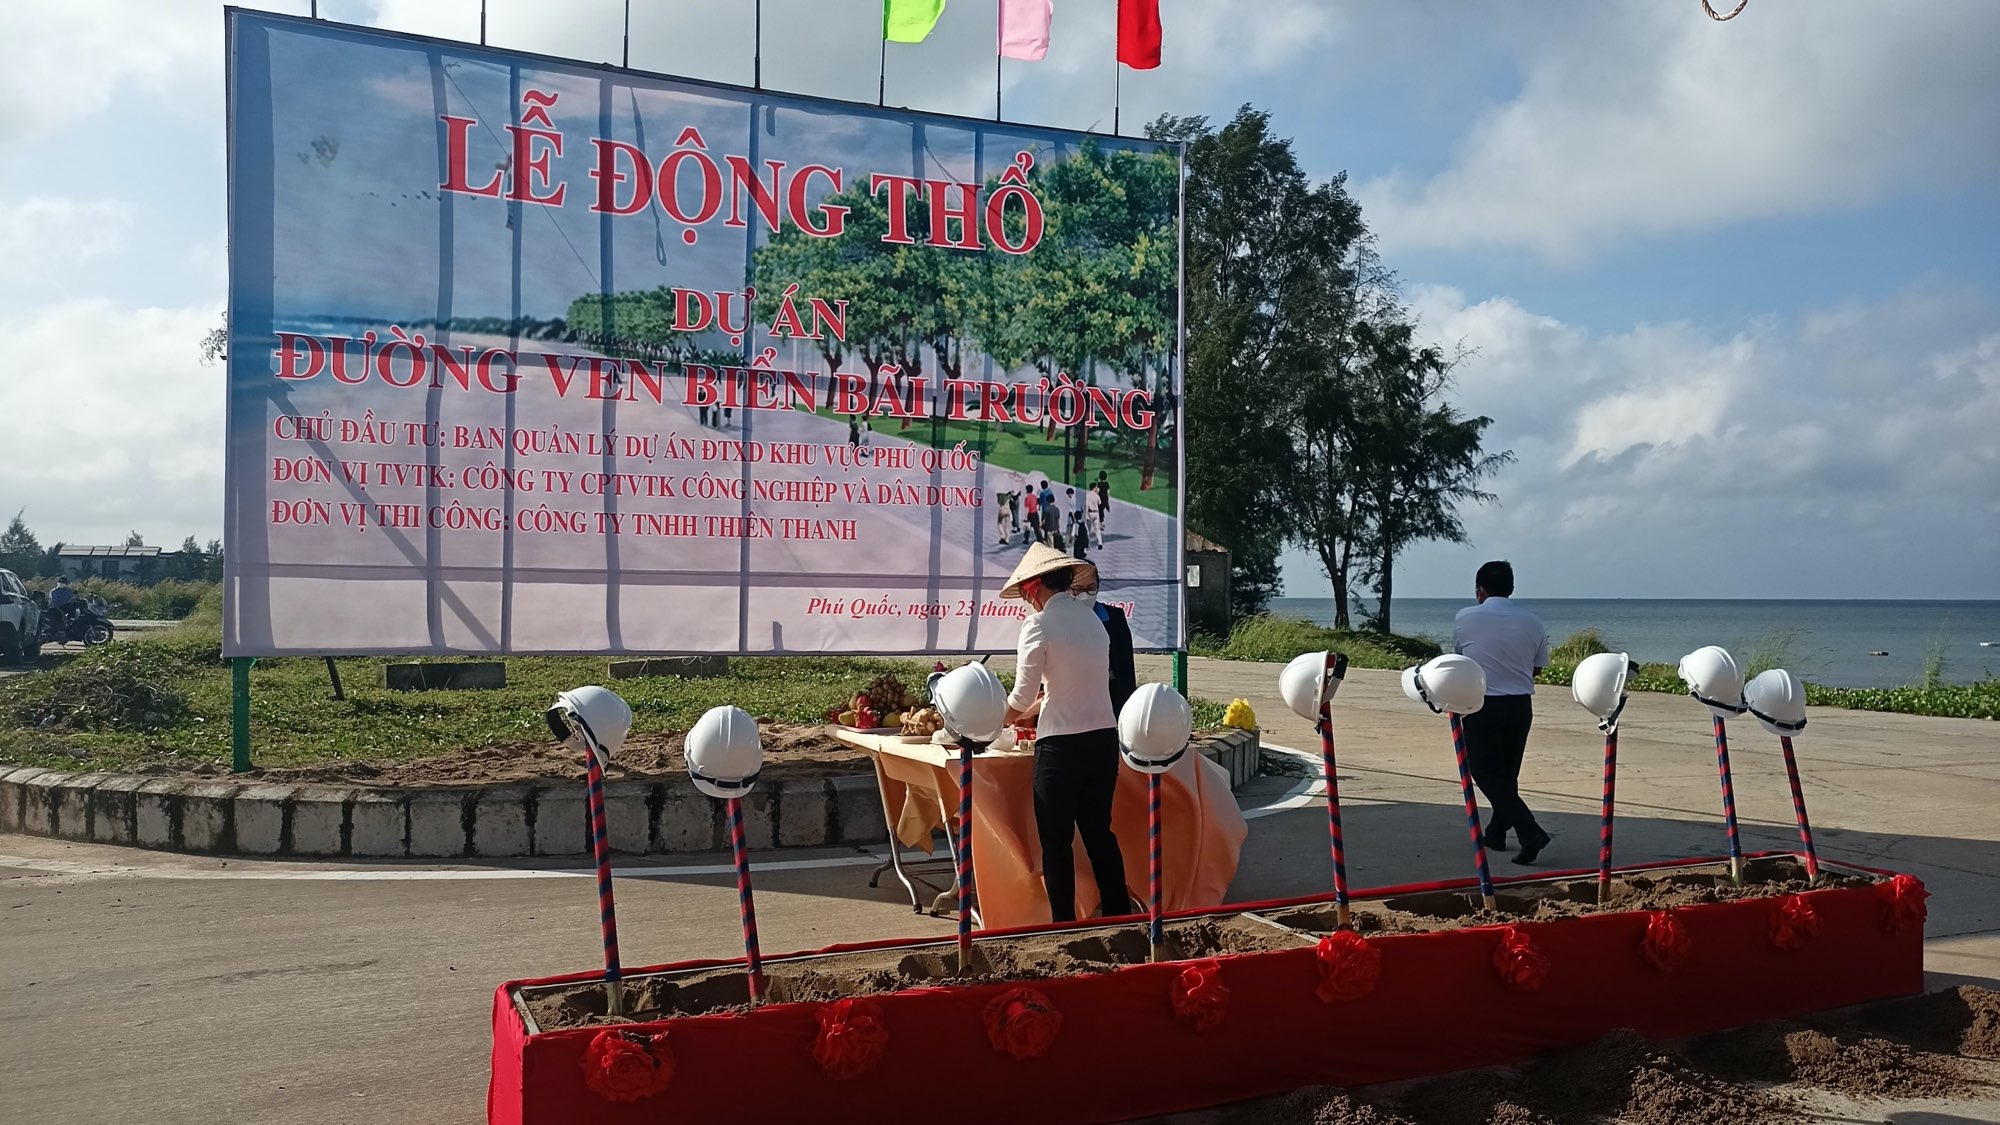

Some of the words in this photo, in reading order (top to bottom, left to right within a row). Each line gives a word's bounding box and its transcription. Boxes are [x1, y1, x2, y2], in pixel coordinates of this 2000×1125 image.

[440, 89, 567, 208] LỄ
[589, 126, 851, 245] ĐỘNG
[871, 151, 1045, 254] THỔ
[671, 287, 756, 346] DỰ
[769, 283, 849, 341] ÁN
[274, 325, 523, 394] ĐƯỜNG
[540, 353, 665, 405] VEN
[682, 346, 820, 414] BIỂN
[833, 363, 931, 418] BÃI
[943, 372, 1156, 429] TRƯỜNG
[274, 410, 334, 442] CHỦ
[340, 408, 396, 446] ĐẦU
[403, 420, 446, 448] TƯ:
[453, 425, 506, 450] BAN
[512, 423, 581, 456] QUẢN
[587, 428, 617, 456] LÝ
[625, 434, 659, 464] DỰ
[664, 431, 696, 461] ÁN
[701, 440, 764, 463] ĐTXD
[769, 443, 818, 466] KHU
[823, 444, 869, 474] VỰC
[873, 442, 917, 470] PHÚ
[921, 440, 981, 475] QUỐC
[273, 456, 332, 484] ĐƠN
[340, 461, 370, 492] VỊ
[376, 463, 455, 489] TVTK:
[462, 461, 535, 494] CÔNG
[541, 470, 574, 495] TY
[580, 472, 676, 500] CPTVTK
[682, 471, 747, 500] CÔNG
[753, 475, 838, 508] NGHIỆP
[844, 478, 872, 505] VÀ
[877, 479, 921, 506] DÂN
[925, 485, 984, 512] DỤNG
[272, 498, 331, 525] ĐƠN
[339, 502, 369, 533] VỊ
[374, 504, 421, 528] THI
[428, 503, 510, 533] CÔNG:
[517, 504, 588, 534] CÔNG
[594, 512, 626, 535] TY
[632, 513, 699, 538] TNHH
[704, 511, 774, 540] THIÊN
[780, 518, 858, 542] THANH
[806, 597, 845, 617] Phú
[850, 594, 902, 621] Quốc,
[907, 600, 951, 620] ngày
[954, 601, 975, 616] 23
[980, 601, 1027, 620] tháng
